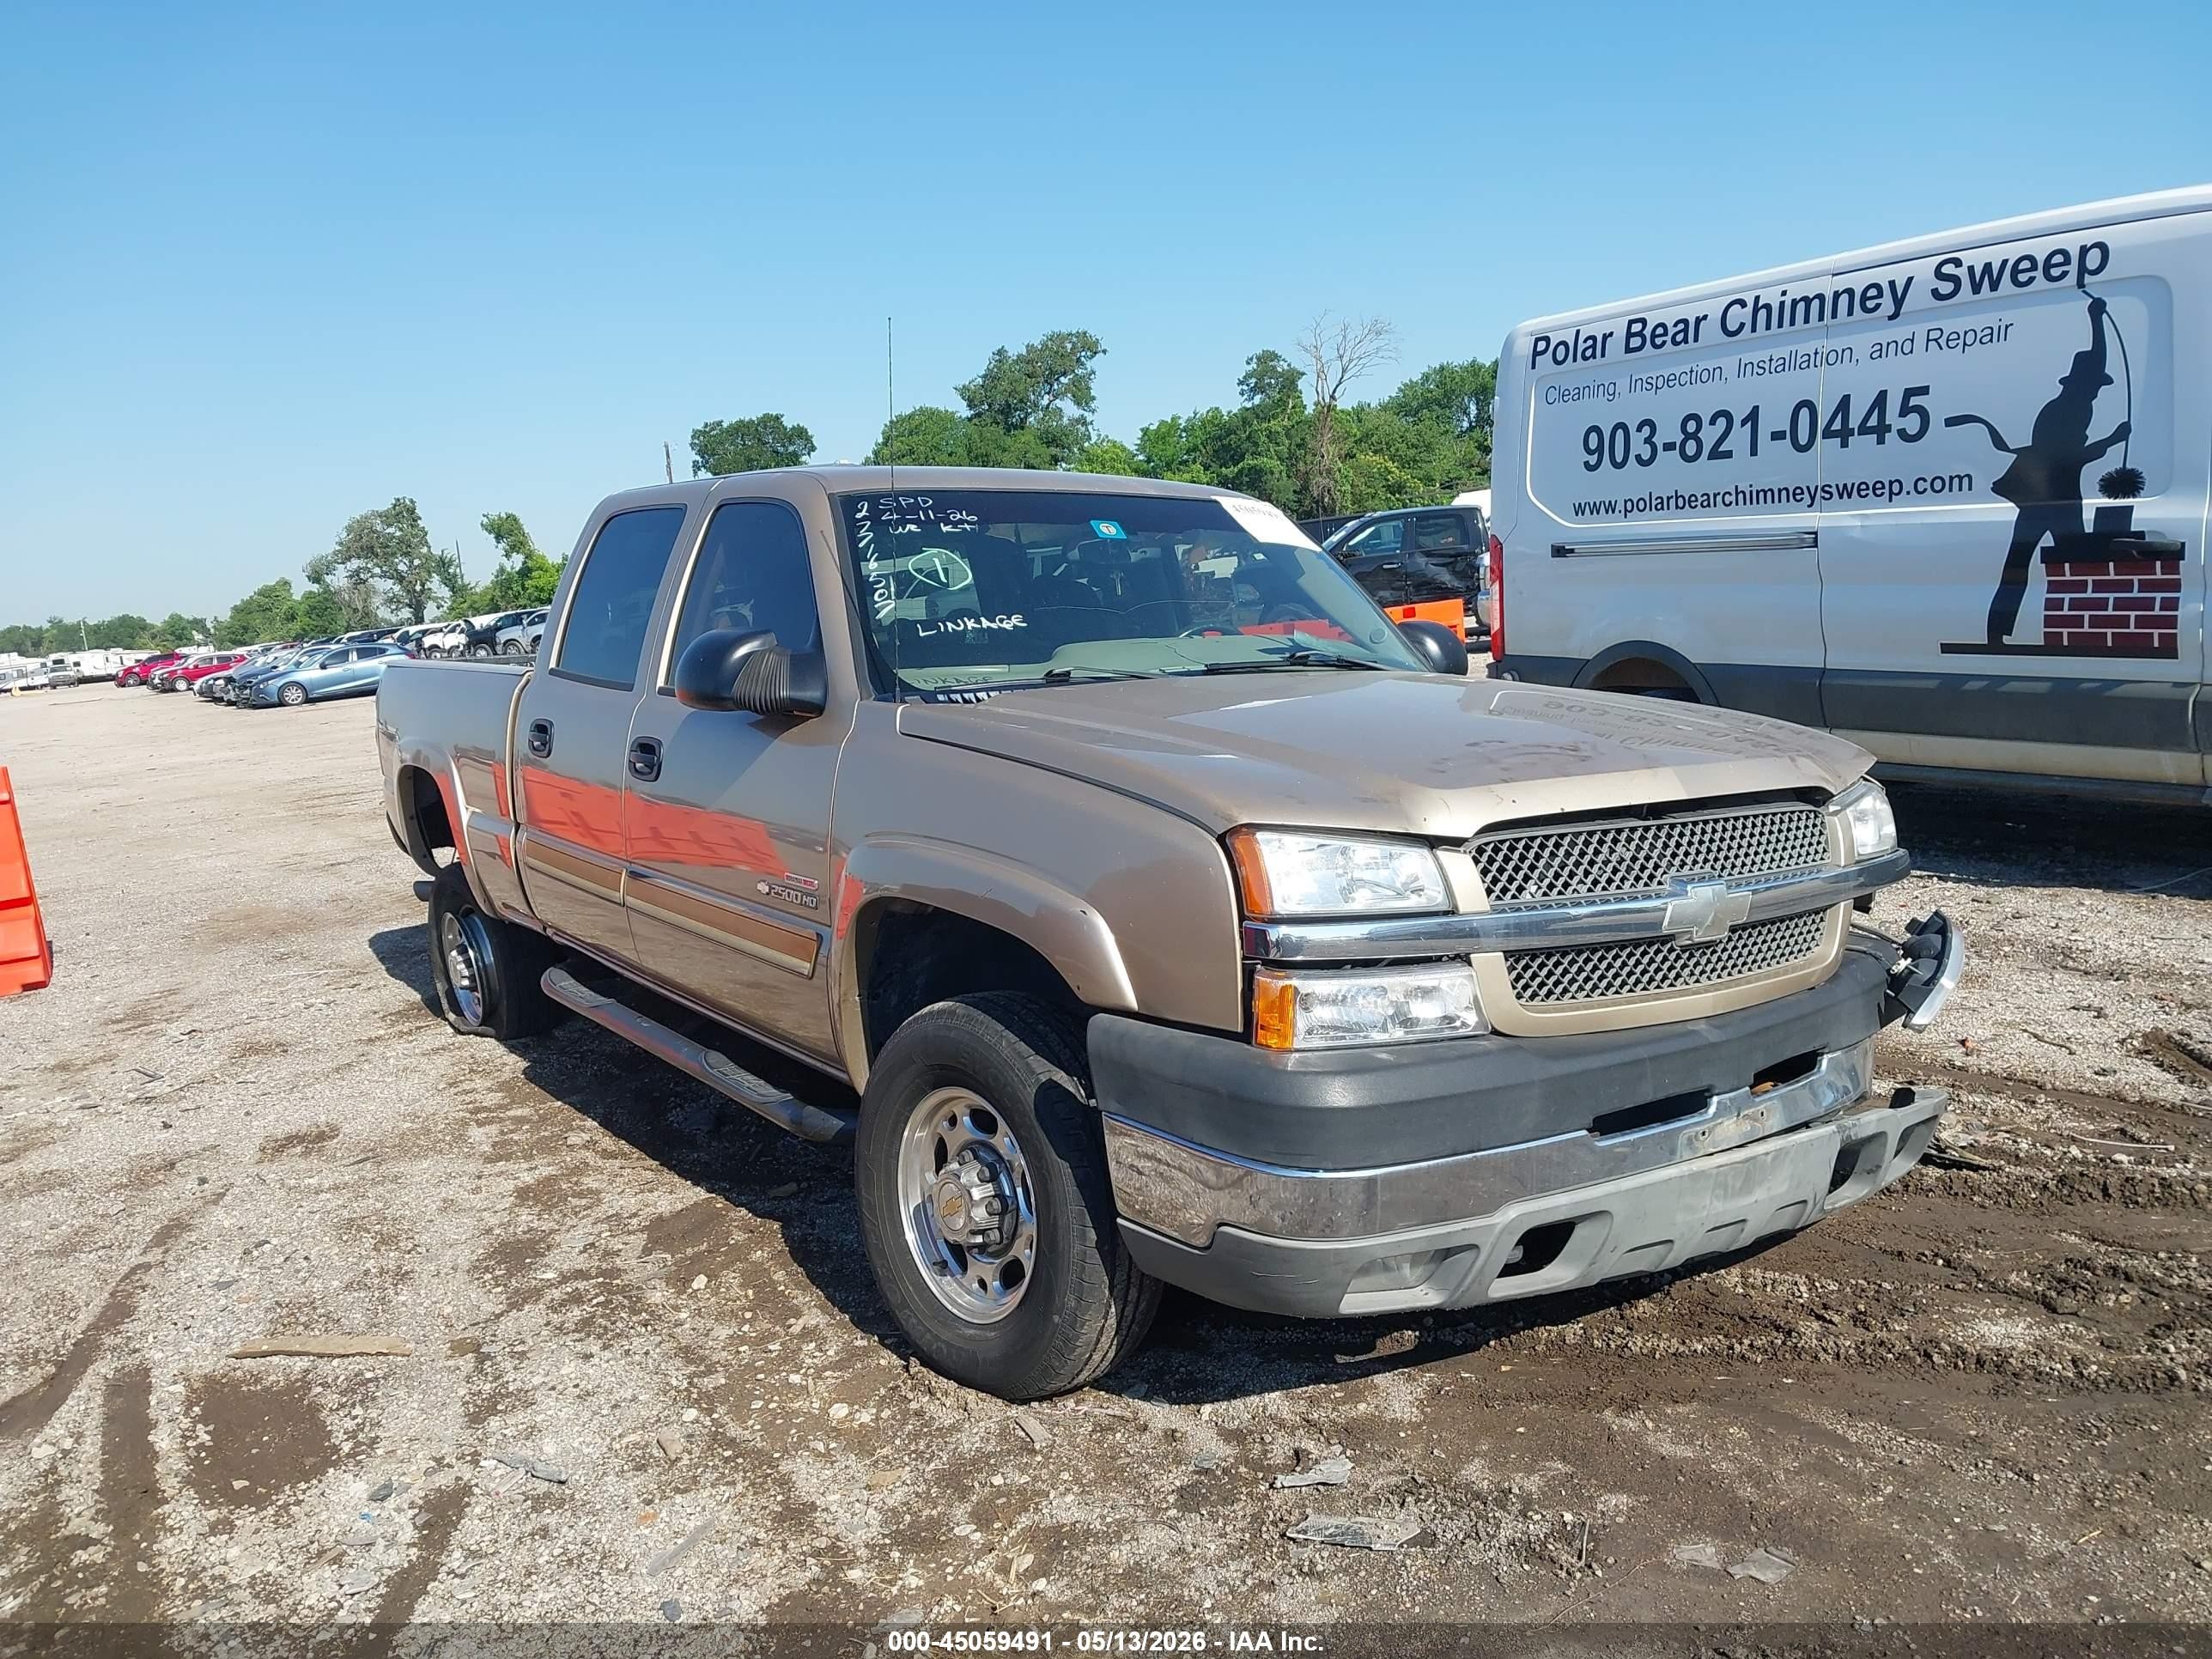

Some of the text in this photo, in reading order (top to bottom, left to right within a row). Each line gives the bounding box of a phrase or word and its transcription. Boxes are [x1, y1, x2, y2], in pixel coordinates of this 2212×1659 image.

[1530, 240, 2110, 370] Polar Bear Chimney Sweep
[1545, 318, 2014, 405] Cleaning, Inspection, Installation, and Repair
[1583, 385, 1930, 472] 903-821-0445
[878, 496, 933, 508] SPD
[881, 509, 978, 521] 4-11-26
[1573, 473, 1973, 518] www.polarbearchimneysweep.com
[916, 614, 1029, 637] LINKAGE
